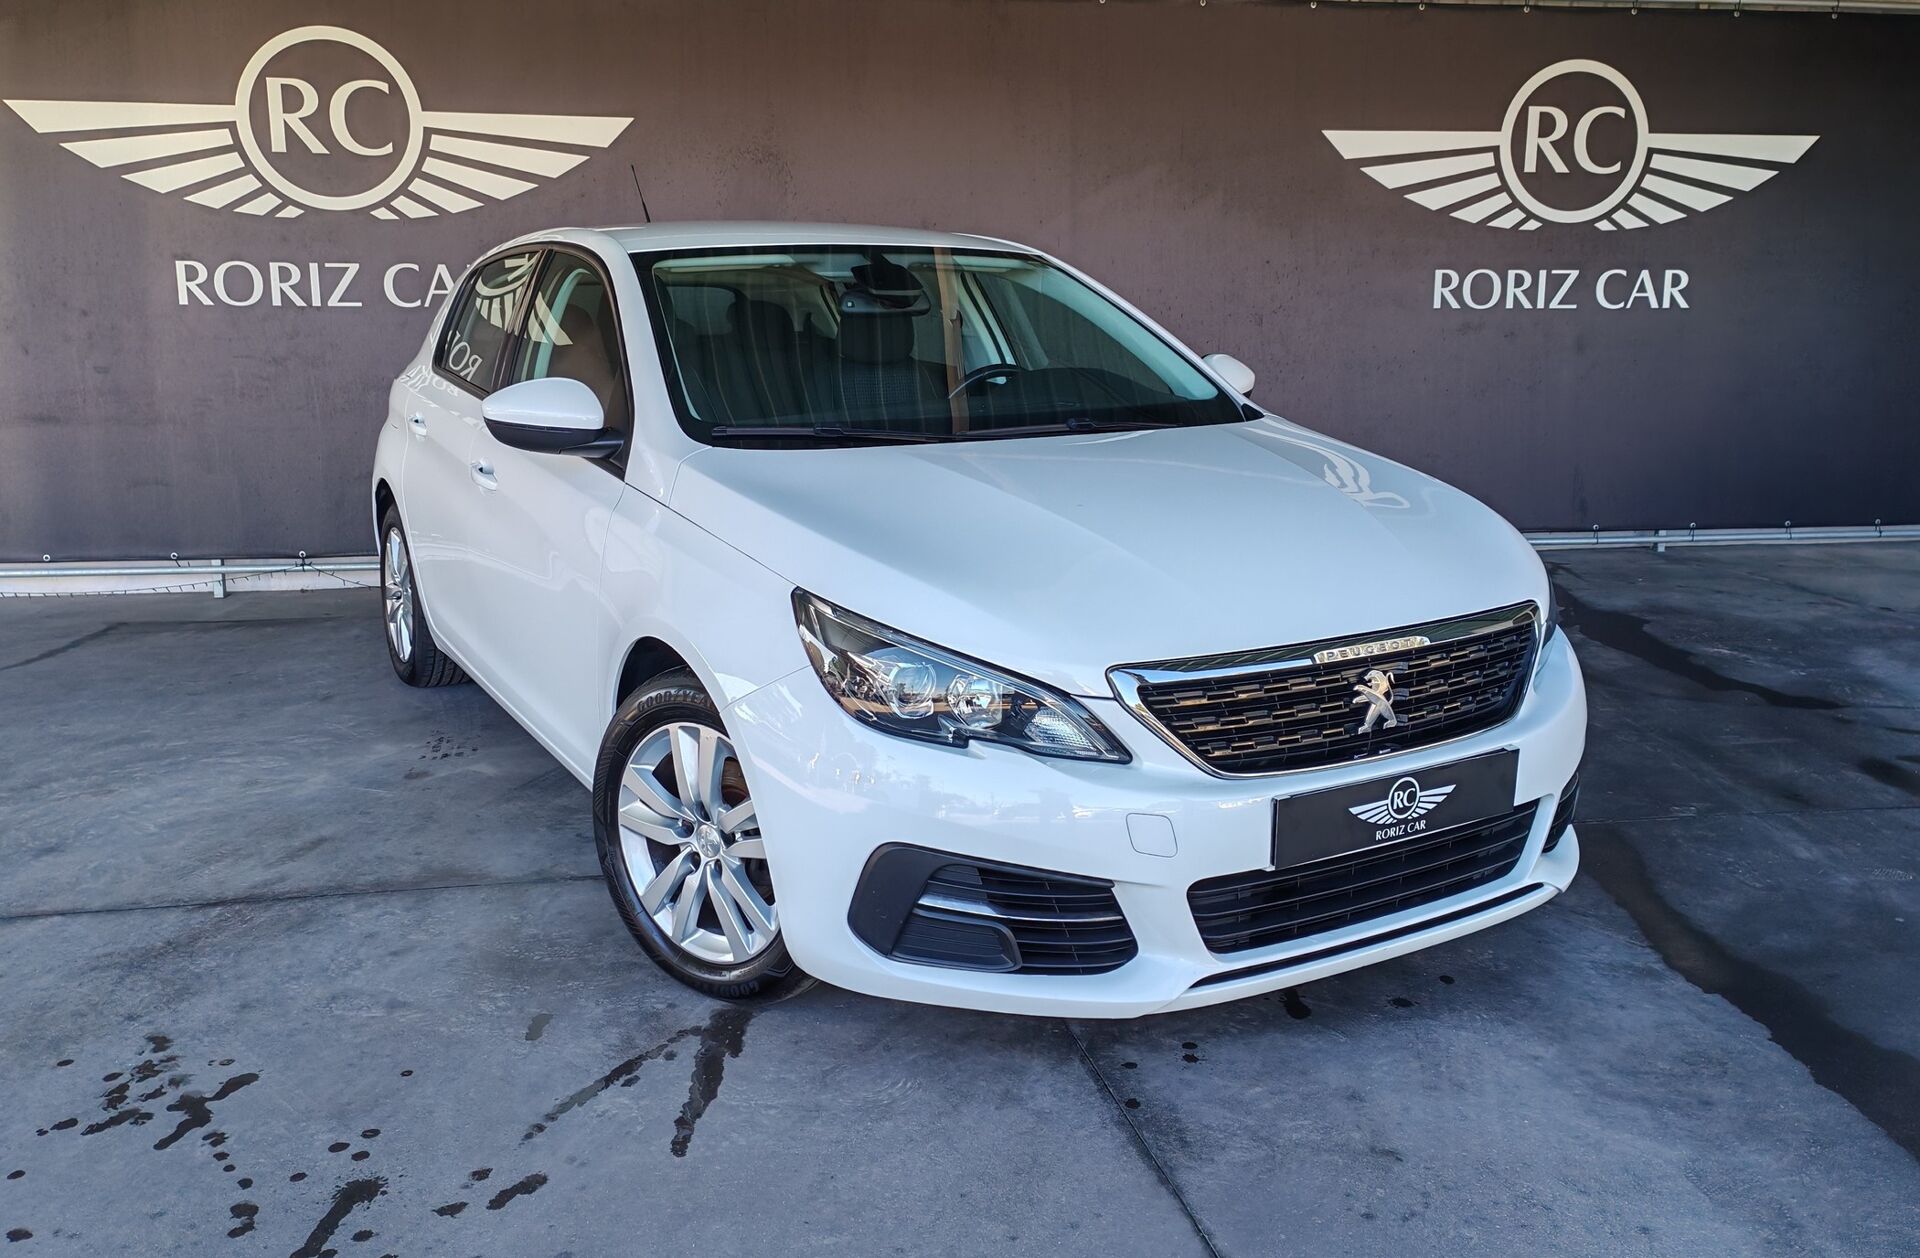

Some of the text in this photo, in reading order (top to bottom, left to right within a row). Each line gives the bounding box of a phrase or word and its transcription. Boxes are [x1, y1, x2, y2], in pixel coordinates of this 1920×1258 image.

[265, 76, 394, 157] RC
[1523, 105, 1626, 174] RC
[174, 260, 470, 308] RORIZ CA
[1433, 268, 1690, 309] RORIZ CAR
[1326, 640, 1414, 661] PEUGEOT
[1393, 787, 1416, 810] RC
[1375, 819, 1427, 841] RORIZ CAR
